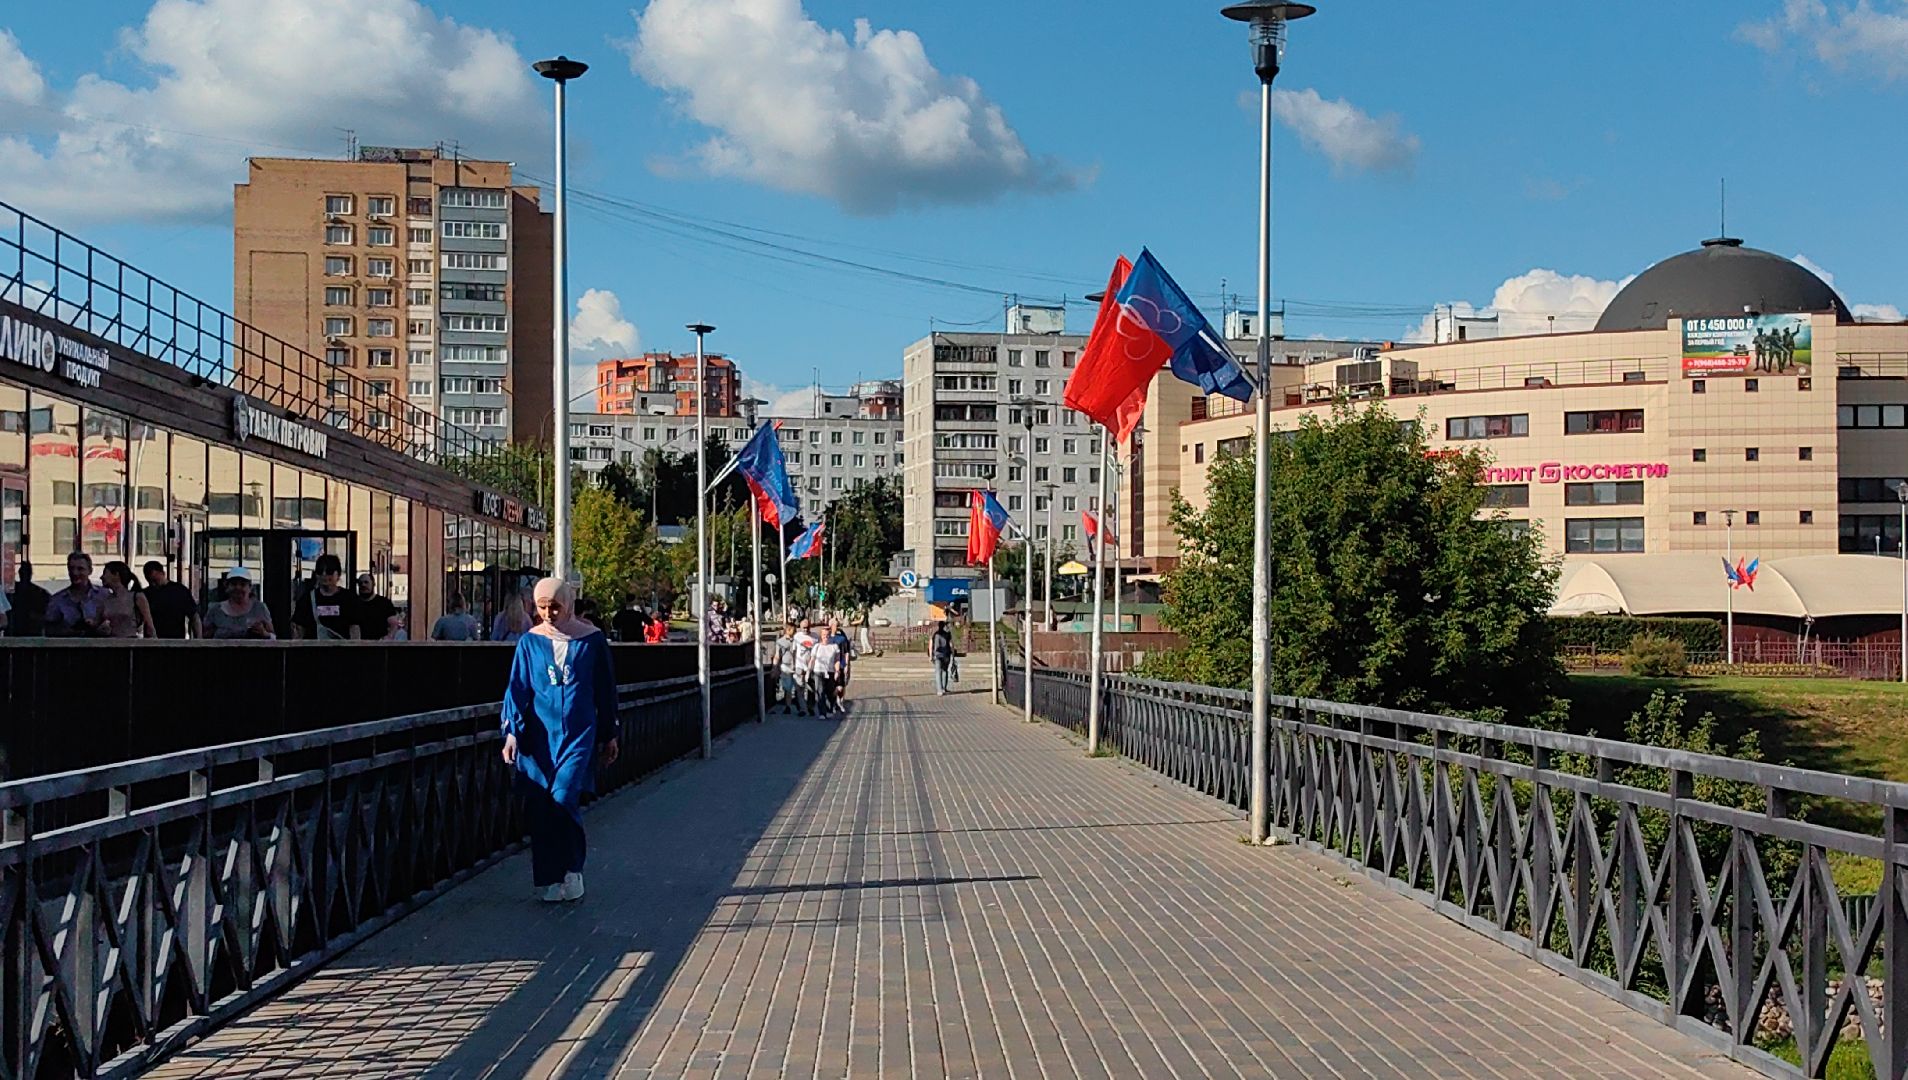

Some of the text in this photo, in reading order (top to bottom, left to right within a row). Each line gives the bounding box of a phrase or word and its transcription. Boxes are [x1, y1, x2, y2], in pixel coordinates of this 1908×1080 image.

[1687, 319, 1698, 331] ОТ
[1700, 319, 1706, 330] 5
[1708, 319, 1725, 330] 450
[1727, 319, 1744, 330] 000
[58, 335, 110, 371] УНИКАЛЬНЫЙ
[66, 361, 101, 388] ПРОДУКТ
[248, 406, 328, 459] ТАБАК ПЕТРОВИЧ
[1480, 466, 1536, 483] ГНИТ
